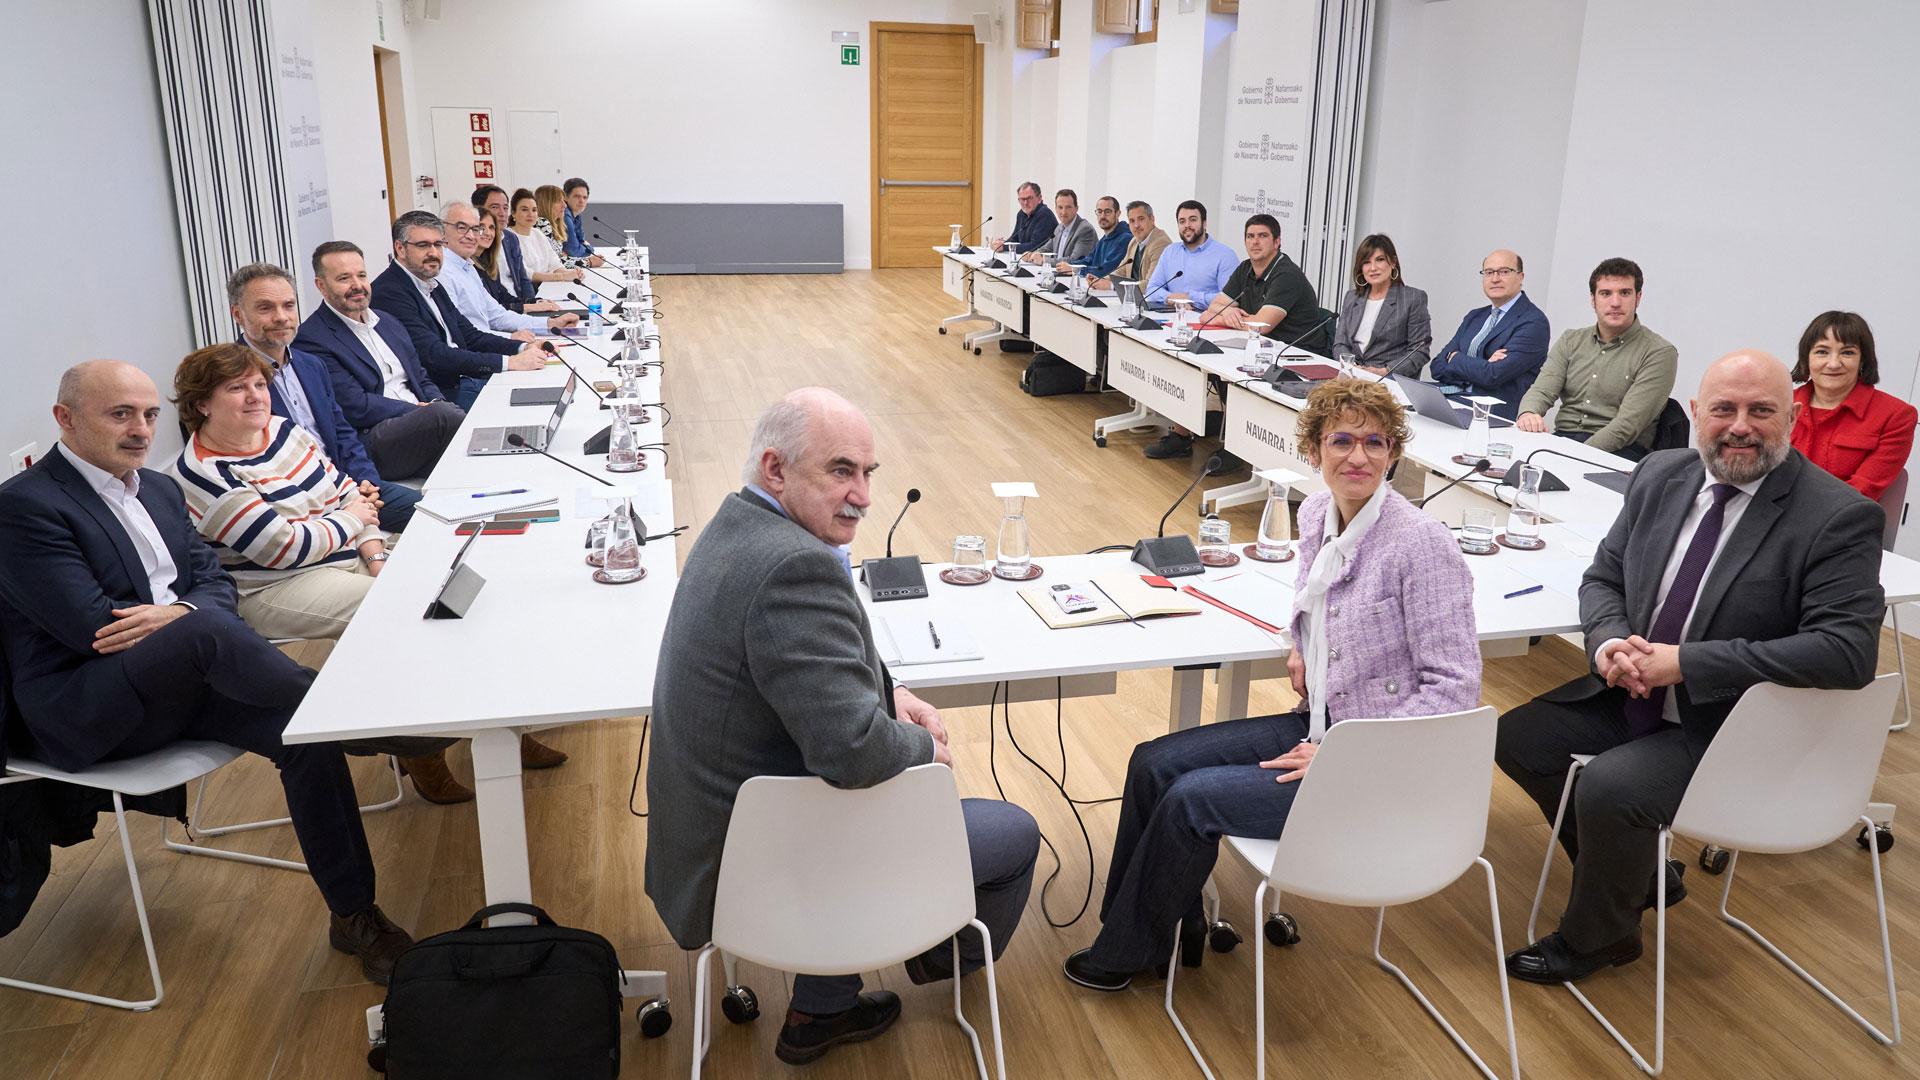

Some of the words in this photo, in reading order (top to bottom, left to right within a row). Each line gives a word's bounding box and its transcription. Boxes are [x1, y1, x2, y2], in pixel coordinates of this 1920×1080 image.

[1120, 359, 1145, 381] NAVARRA
[1152, 375, 1185, 402] NAFARROA
[1246, 420, 1285, 453] NAVARRA
